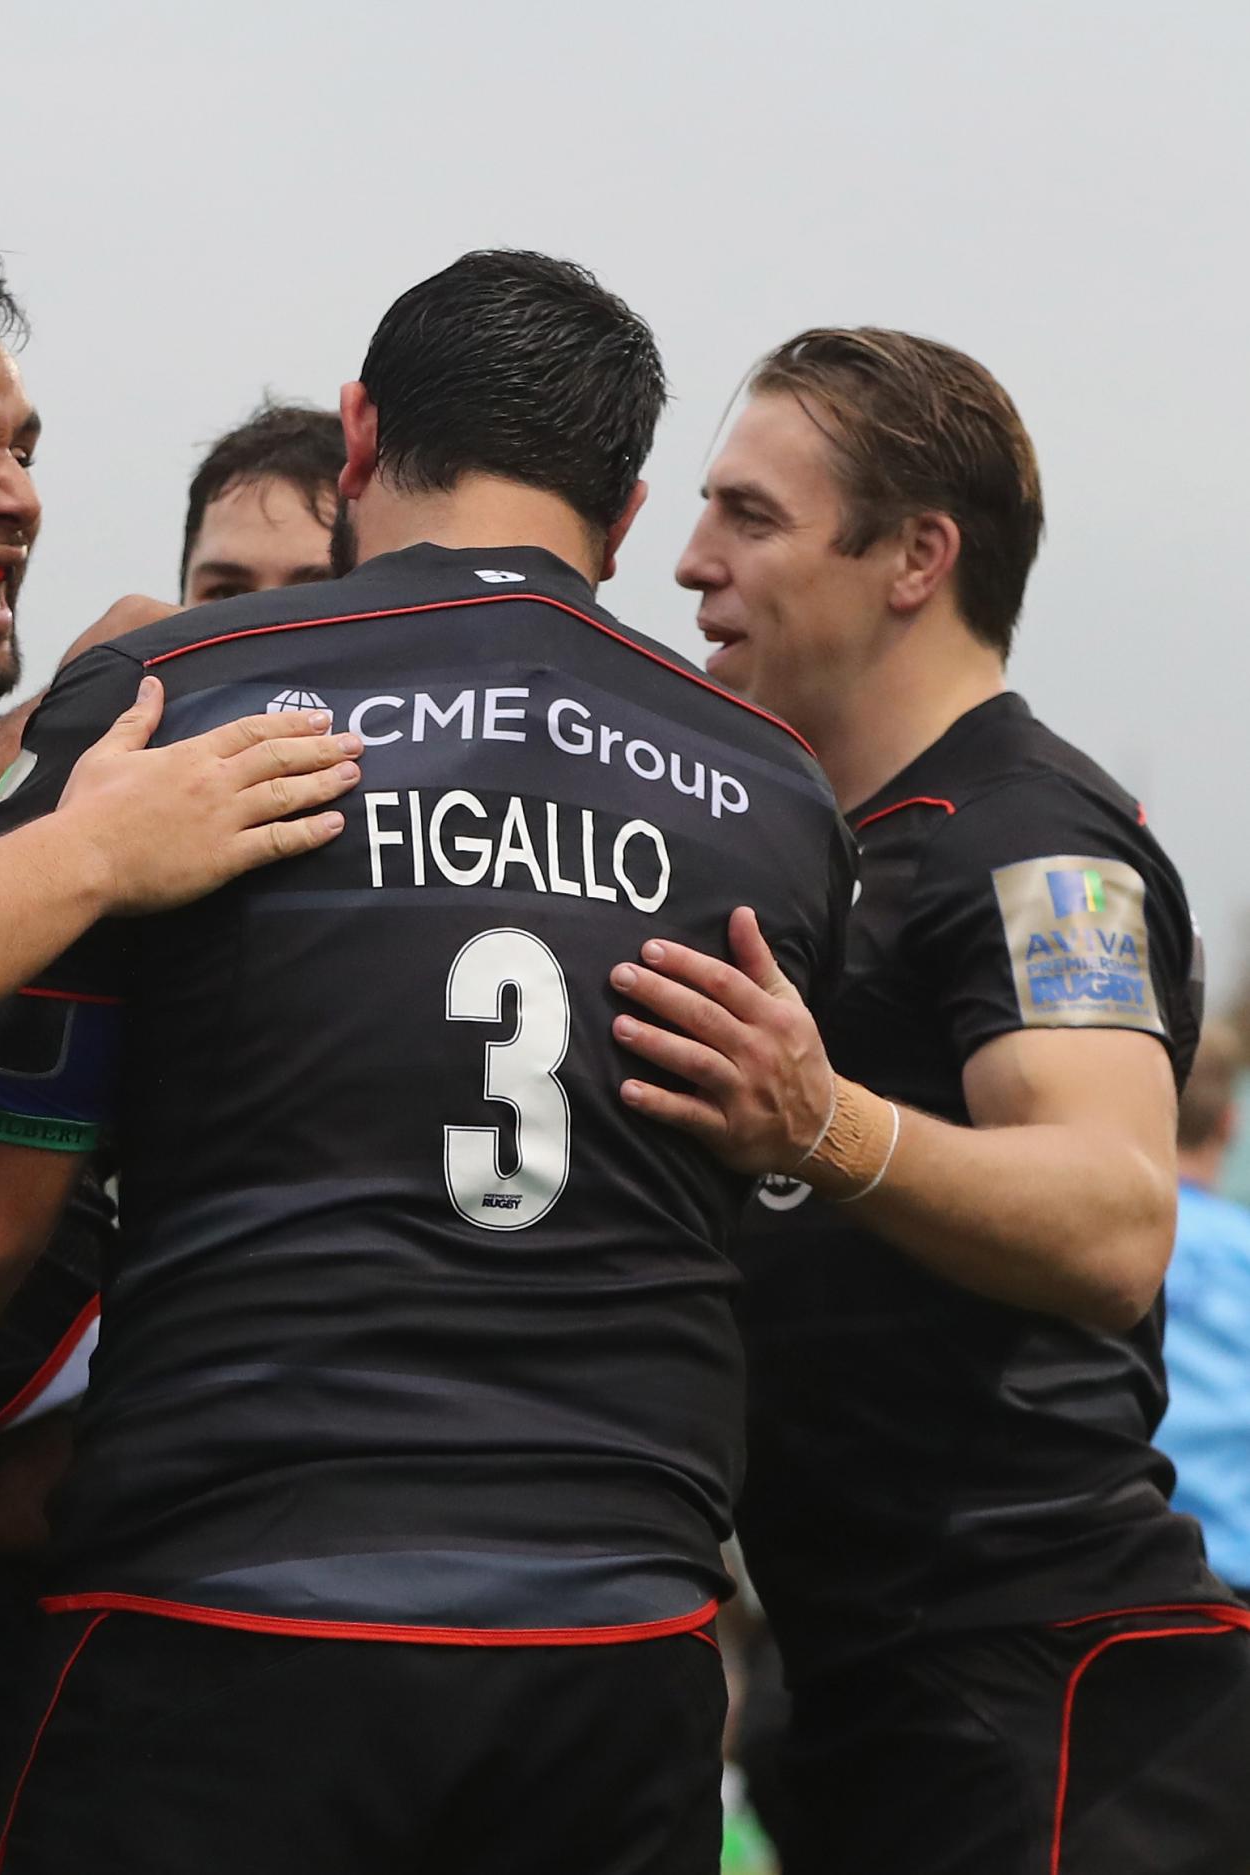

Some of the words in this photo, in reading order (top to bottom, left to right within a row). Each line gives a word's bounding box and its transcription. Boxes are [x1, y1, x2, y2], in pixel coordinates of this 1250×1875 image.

[349, 686, 531, 748] CME
[547, 698, 750, 819] Group
[363, 788, 672, 914] FIGALLO
[444, 927, 571, 1232] 3
[481, 1198, 522, 1210] RUGBY
